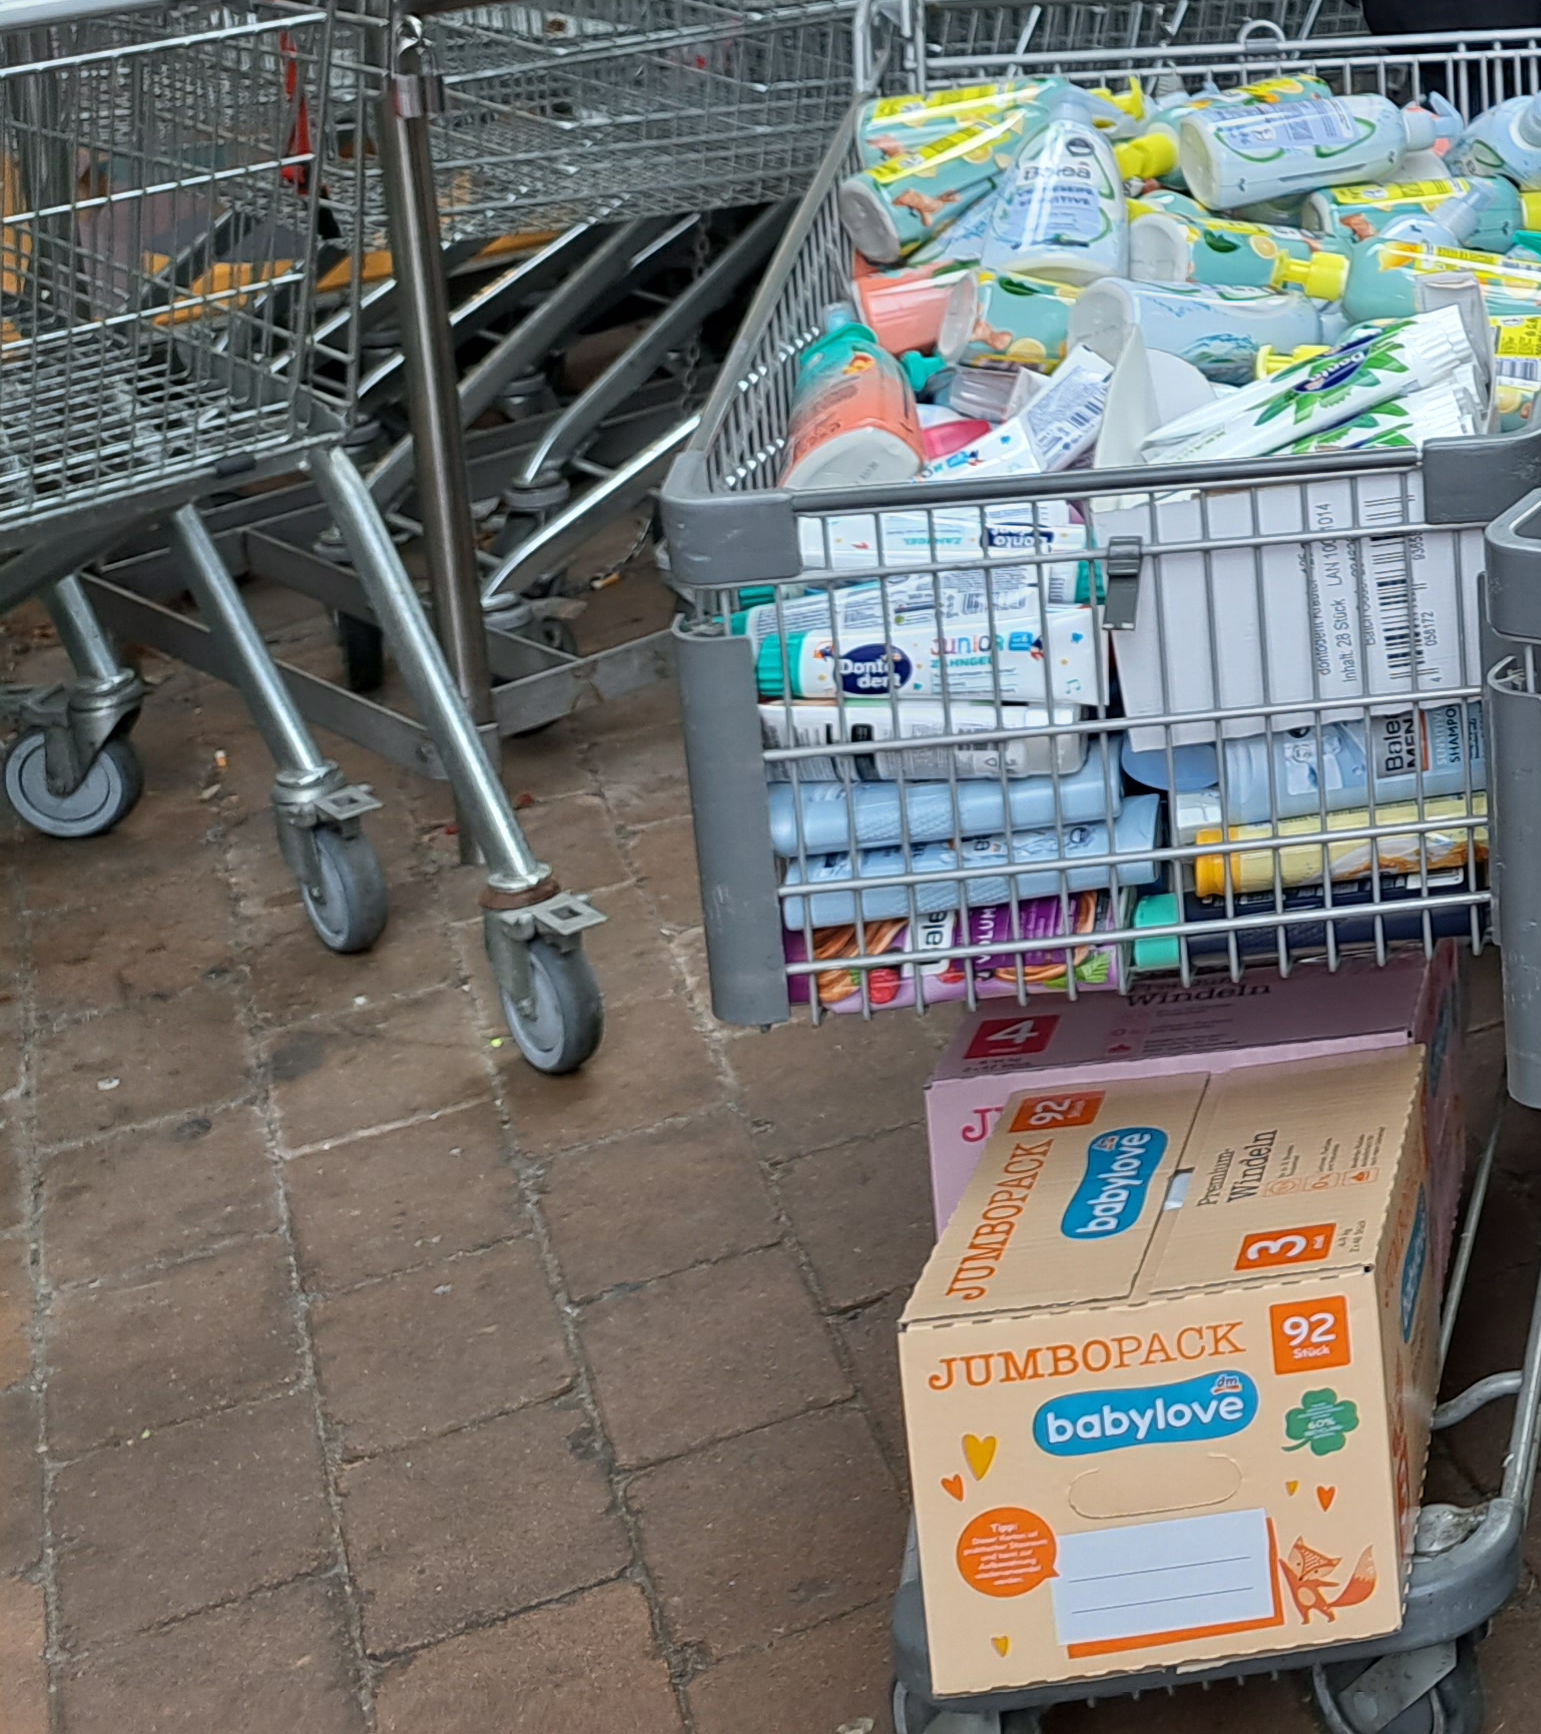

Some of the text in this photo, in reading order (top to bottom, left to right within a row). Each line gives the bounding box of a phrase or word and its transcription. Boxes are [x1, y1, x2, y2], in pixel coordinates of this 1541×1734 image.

[1325, 561, 1342, 586] LAN
[1332, 598, 1350, 632] Stück
[1336, 633, 1352, 649] 28
[1338, 650, 1358, 683] Inhalt:
[1127, 982, 1272, 1008] Windeln
[988, 1019, 1039, 1051] 4
[1029, 1097, 1071, 1125] 92
[1196, 1147, 1236, 1206] Premium-
[1227, 1129, 1278, 1204] Windeln
[1075, 1132, 1151, 1234] babylove
[945, 1138, 1054, 1301] JUMBOPACK
[1246, 1233, 1307, 1260] 3
[1282, 1312, 1337, 1347] 92
[927, 1321, 1247, 1391] JUMBOPACK
[1292, 1344, 1331, 1361] Stück
[1215, 1375, 1239, 1388] dm
[1045, 1393, 1246, 1446] babylove
[1306, 1415, 1336, 1431] 60%
